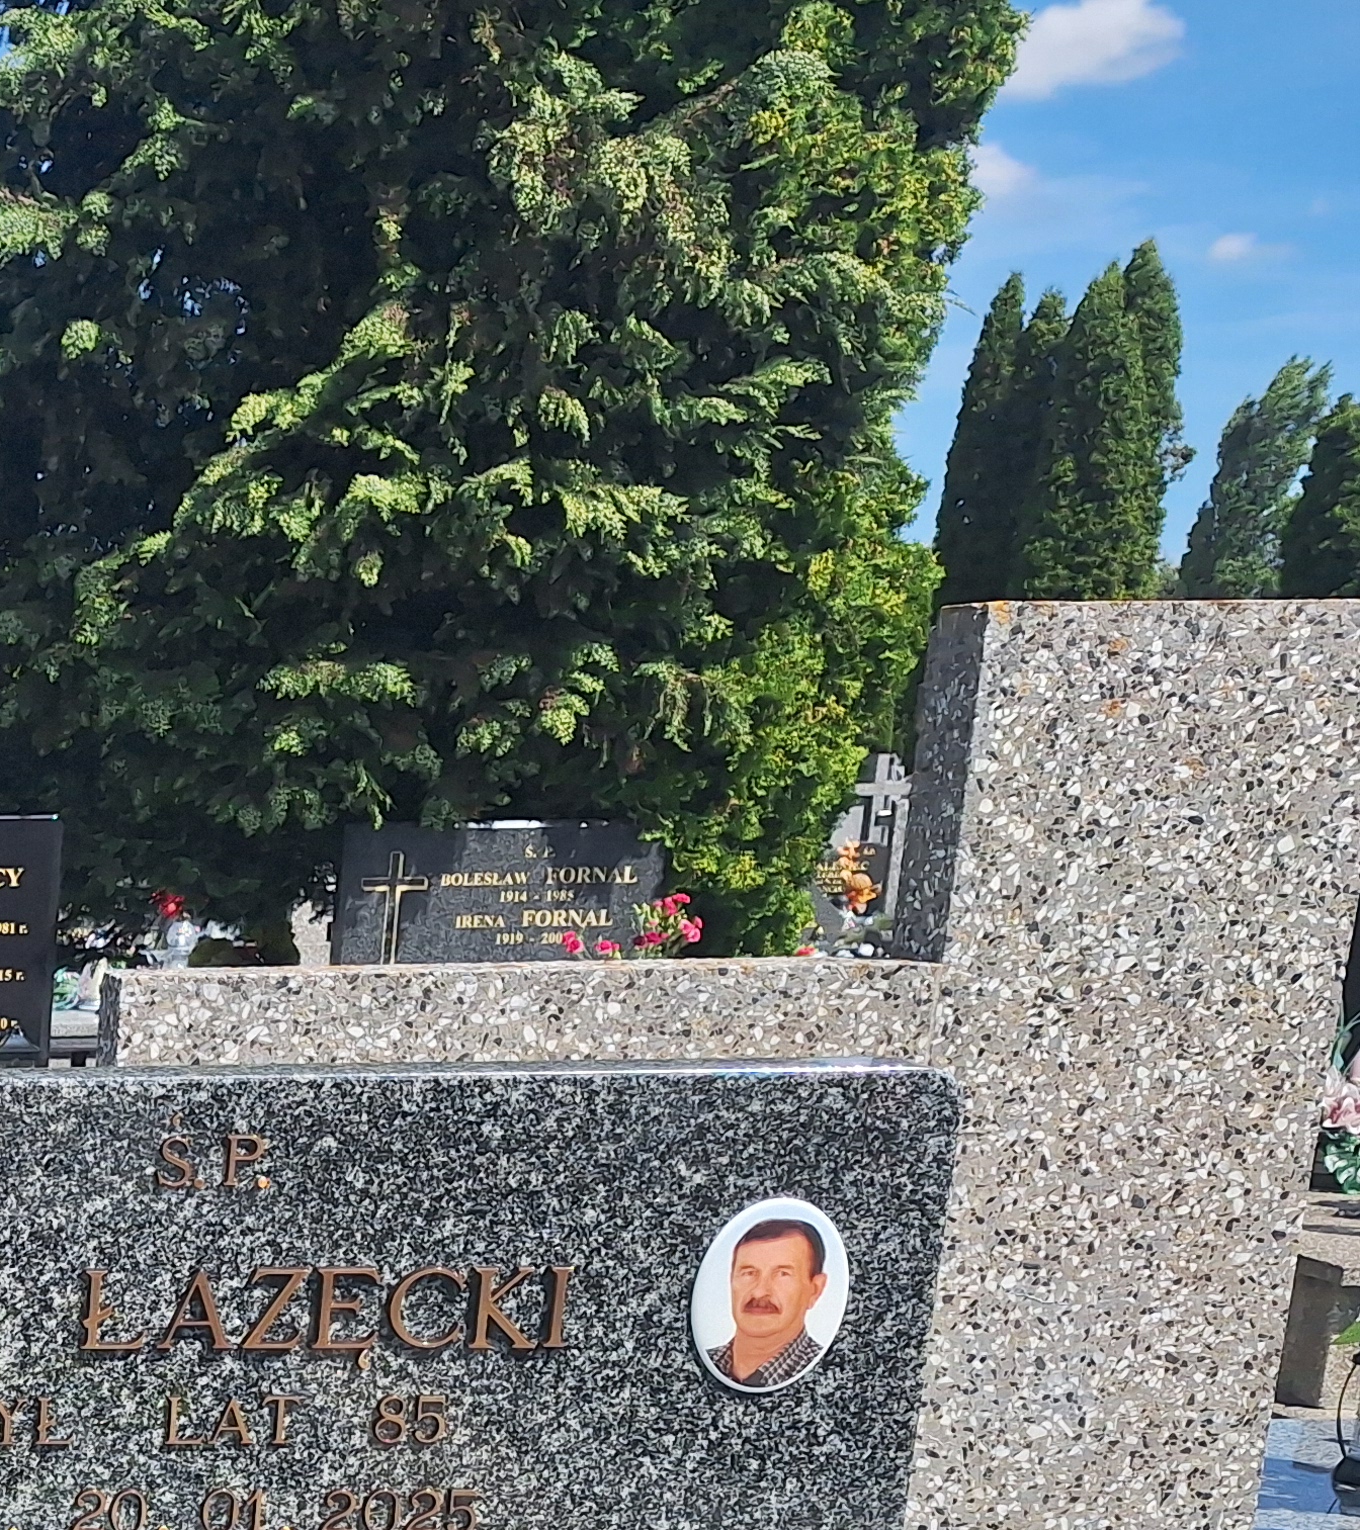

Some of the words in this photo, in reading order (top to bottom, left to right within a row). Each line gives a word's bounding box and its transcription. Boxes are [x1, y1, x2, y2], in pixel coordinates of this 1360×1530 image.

[440, 871, 530, 887] BOLESŁAW
[546, 865, 638, 886] FORNAL
[499, 889, 528, 903] 1914
[455, 914, 506, 929] IRENA
[521, 907, 614, 928] FORNAL
[495, 931, 524, 945] 1919
[540, 931, 568, 945] 200
[81, 1266, 575, 1369] ŁAZĘCKI
[165, 1395, 302, 1446] LAT
[374, 1395, 448, 1445] 85
